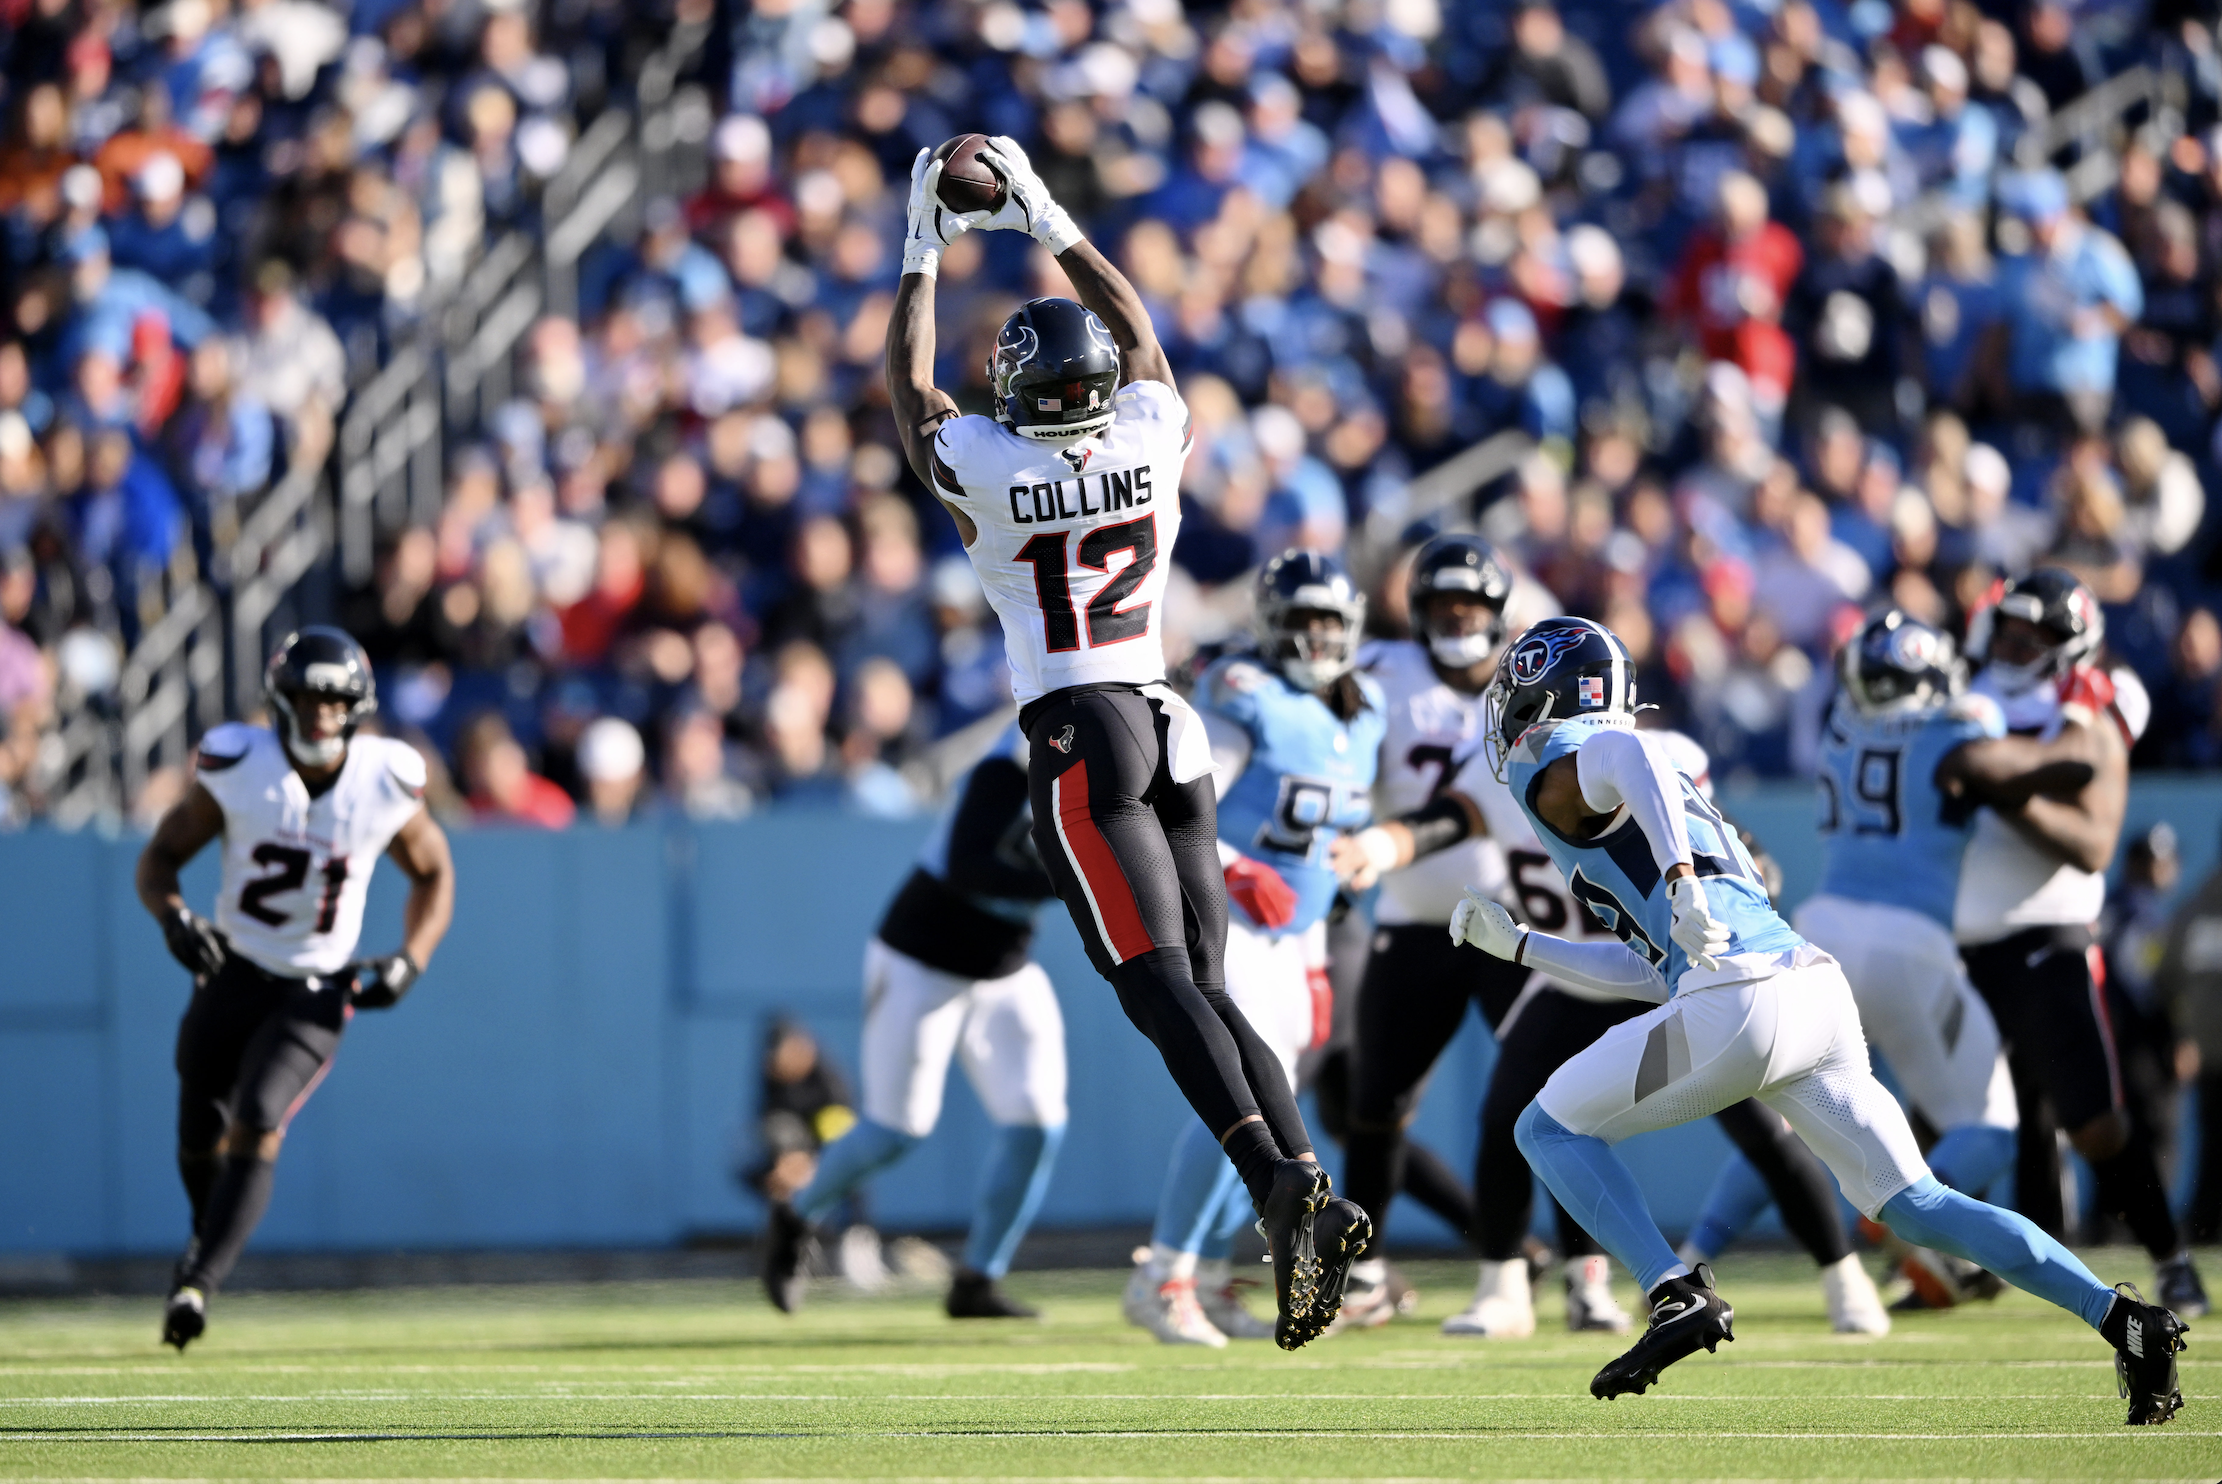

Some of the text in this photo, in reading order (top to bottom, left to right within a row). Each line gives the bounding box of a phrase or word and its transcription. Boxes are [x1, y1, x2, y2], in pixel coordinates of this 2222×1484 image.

[1033, 421, 1108, 438] HOUSTON
[1009, 465, 1152, 524] COLLINS
[1012, 510, 1158, 654] 12
[239, 842, 348, 934] 21
[2126, 1314, 2145, 1359] NIKE
